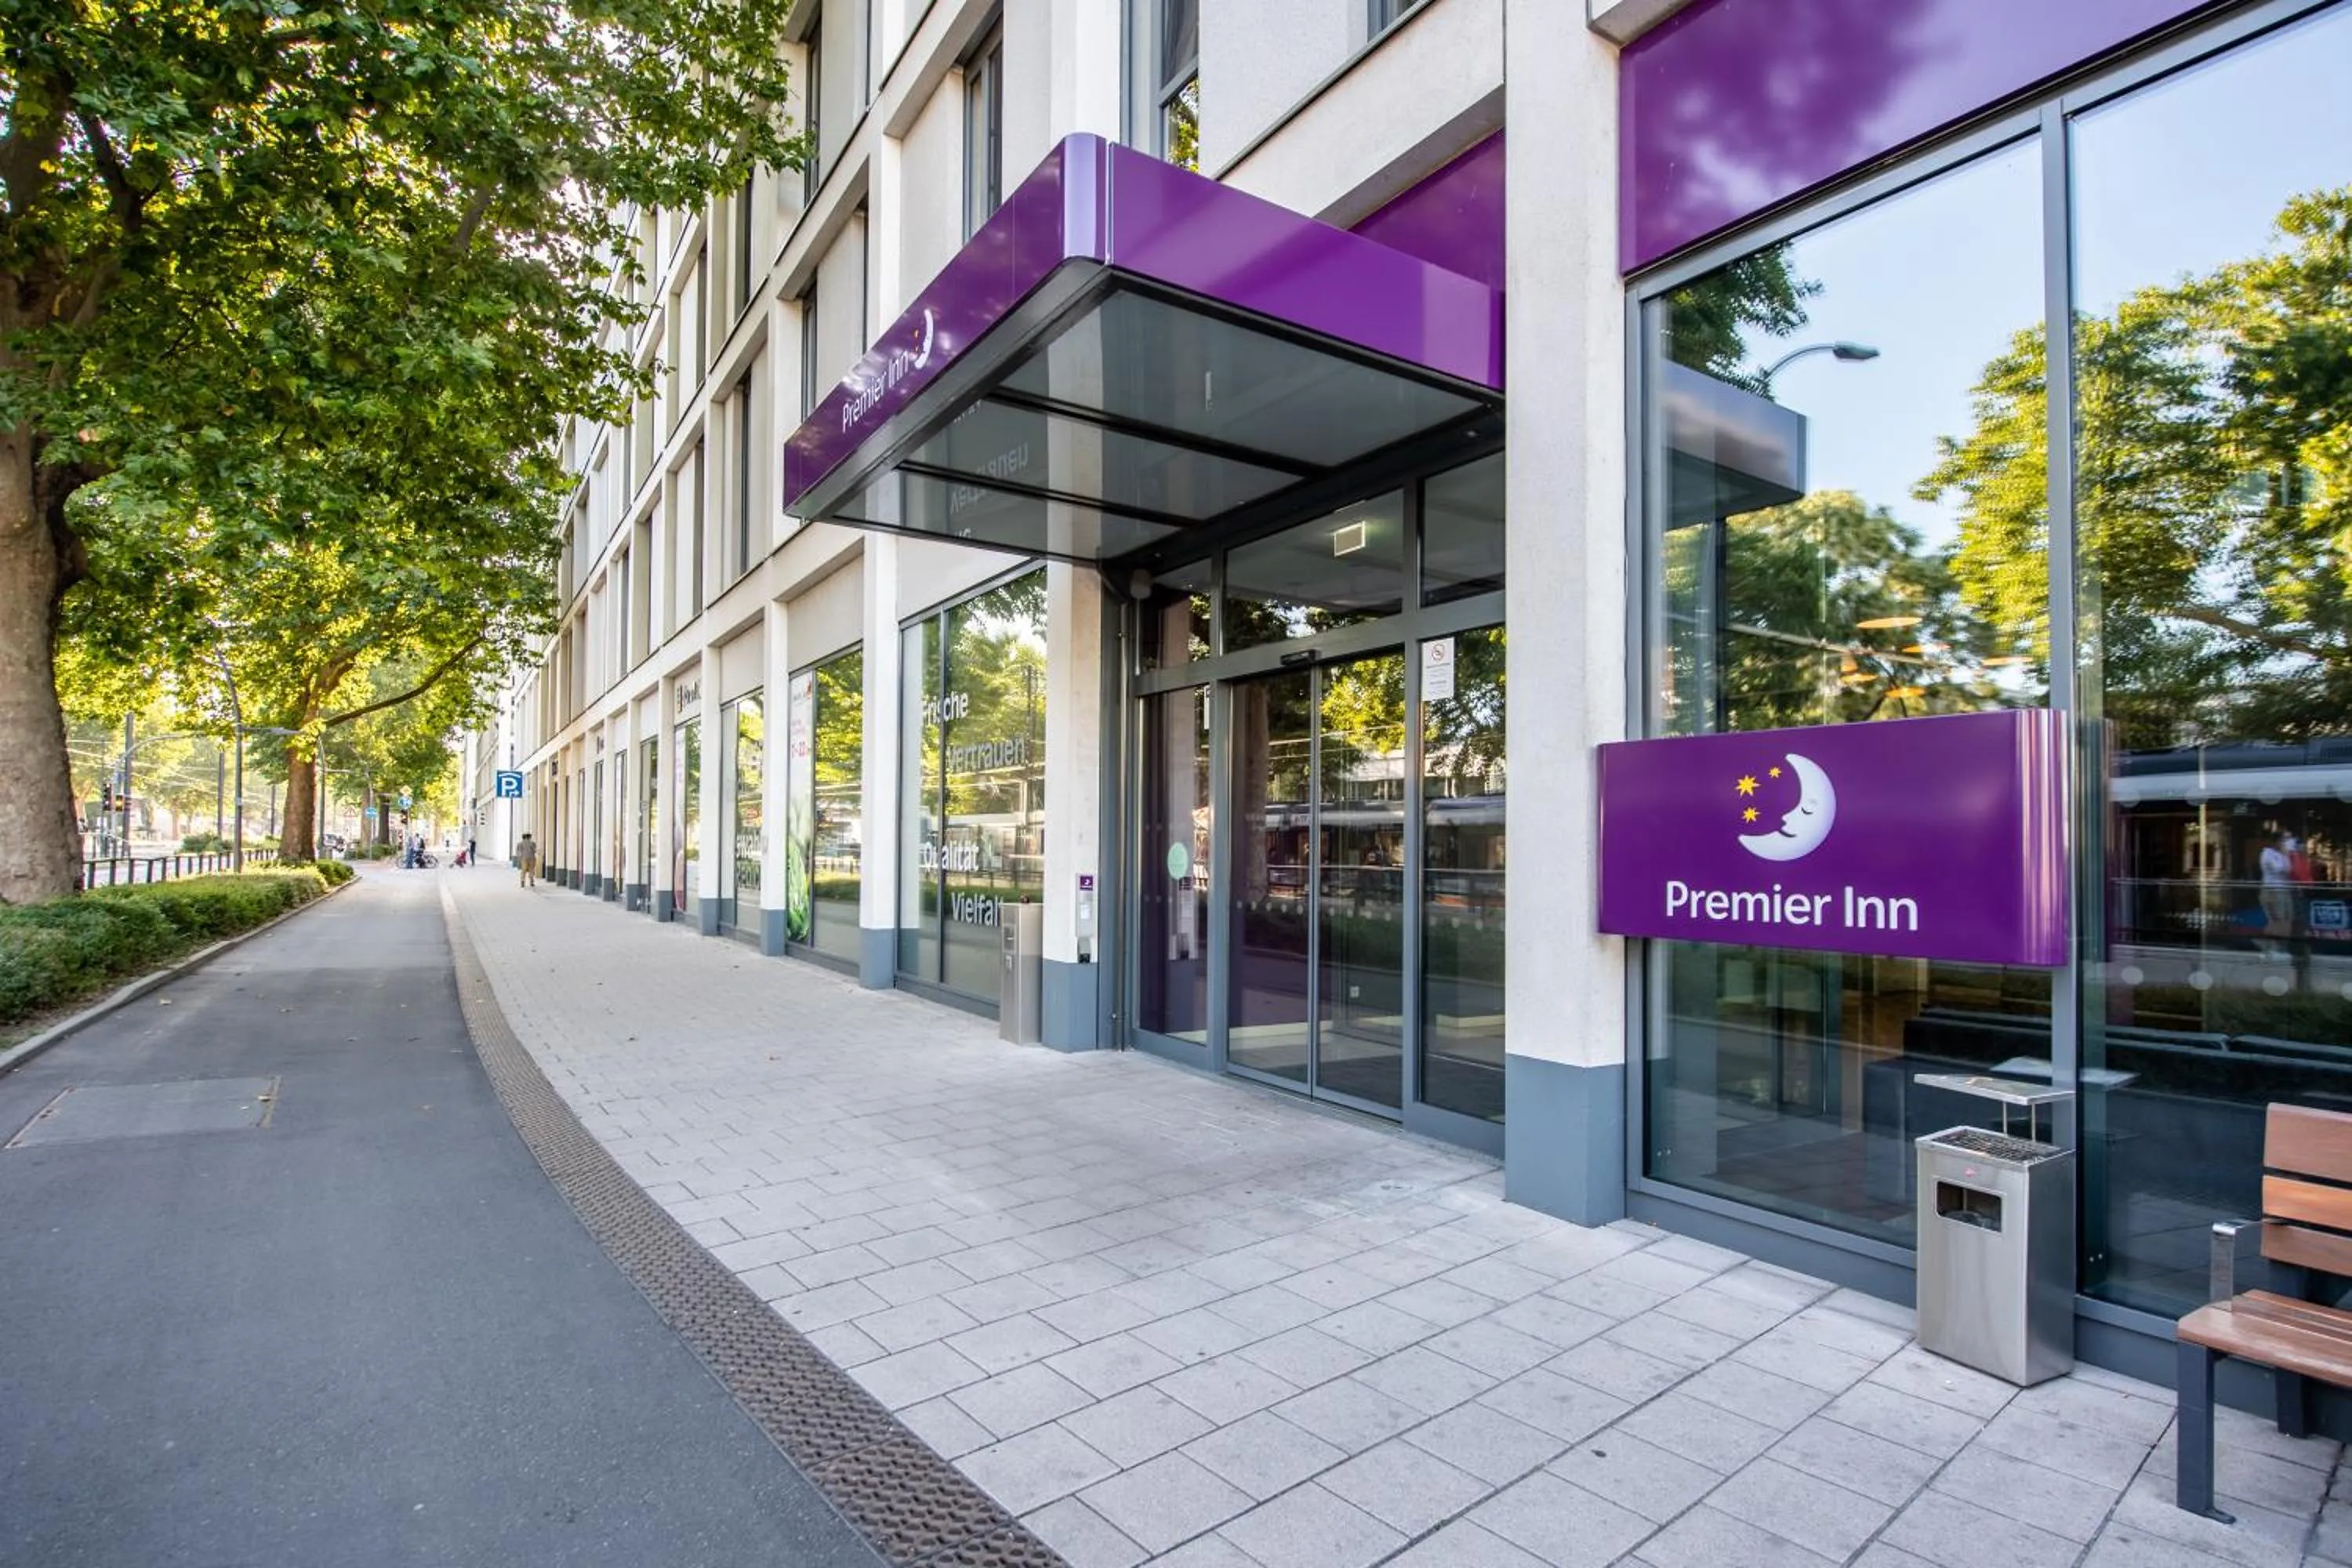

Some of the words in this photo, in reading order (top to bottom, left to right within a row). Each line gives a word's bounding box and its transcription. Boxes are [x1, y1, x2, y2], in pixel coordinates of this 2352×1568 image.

[842, 370, 887, 434] Premier
[887, 350, 909, 390] Inn
[946, 735, 1025, 772] Vertrauen
[501, 776, 519, 797] P
[1665, 880, 1832, 926] Premier
[1844, 885, 1919, 931] Inn
